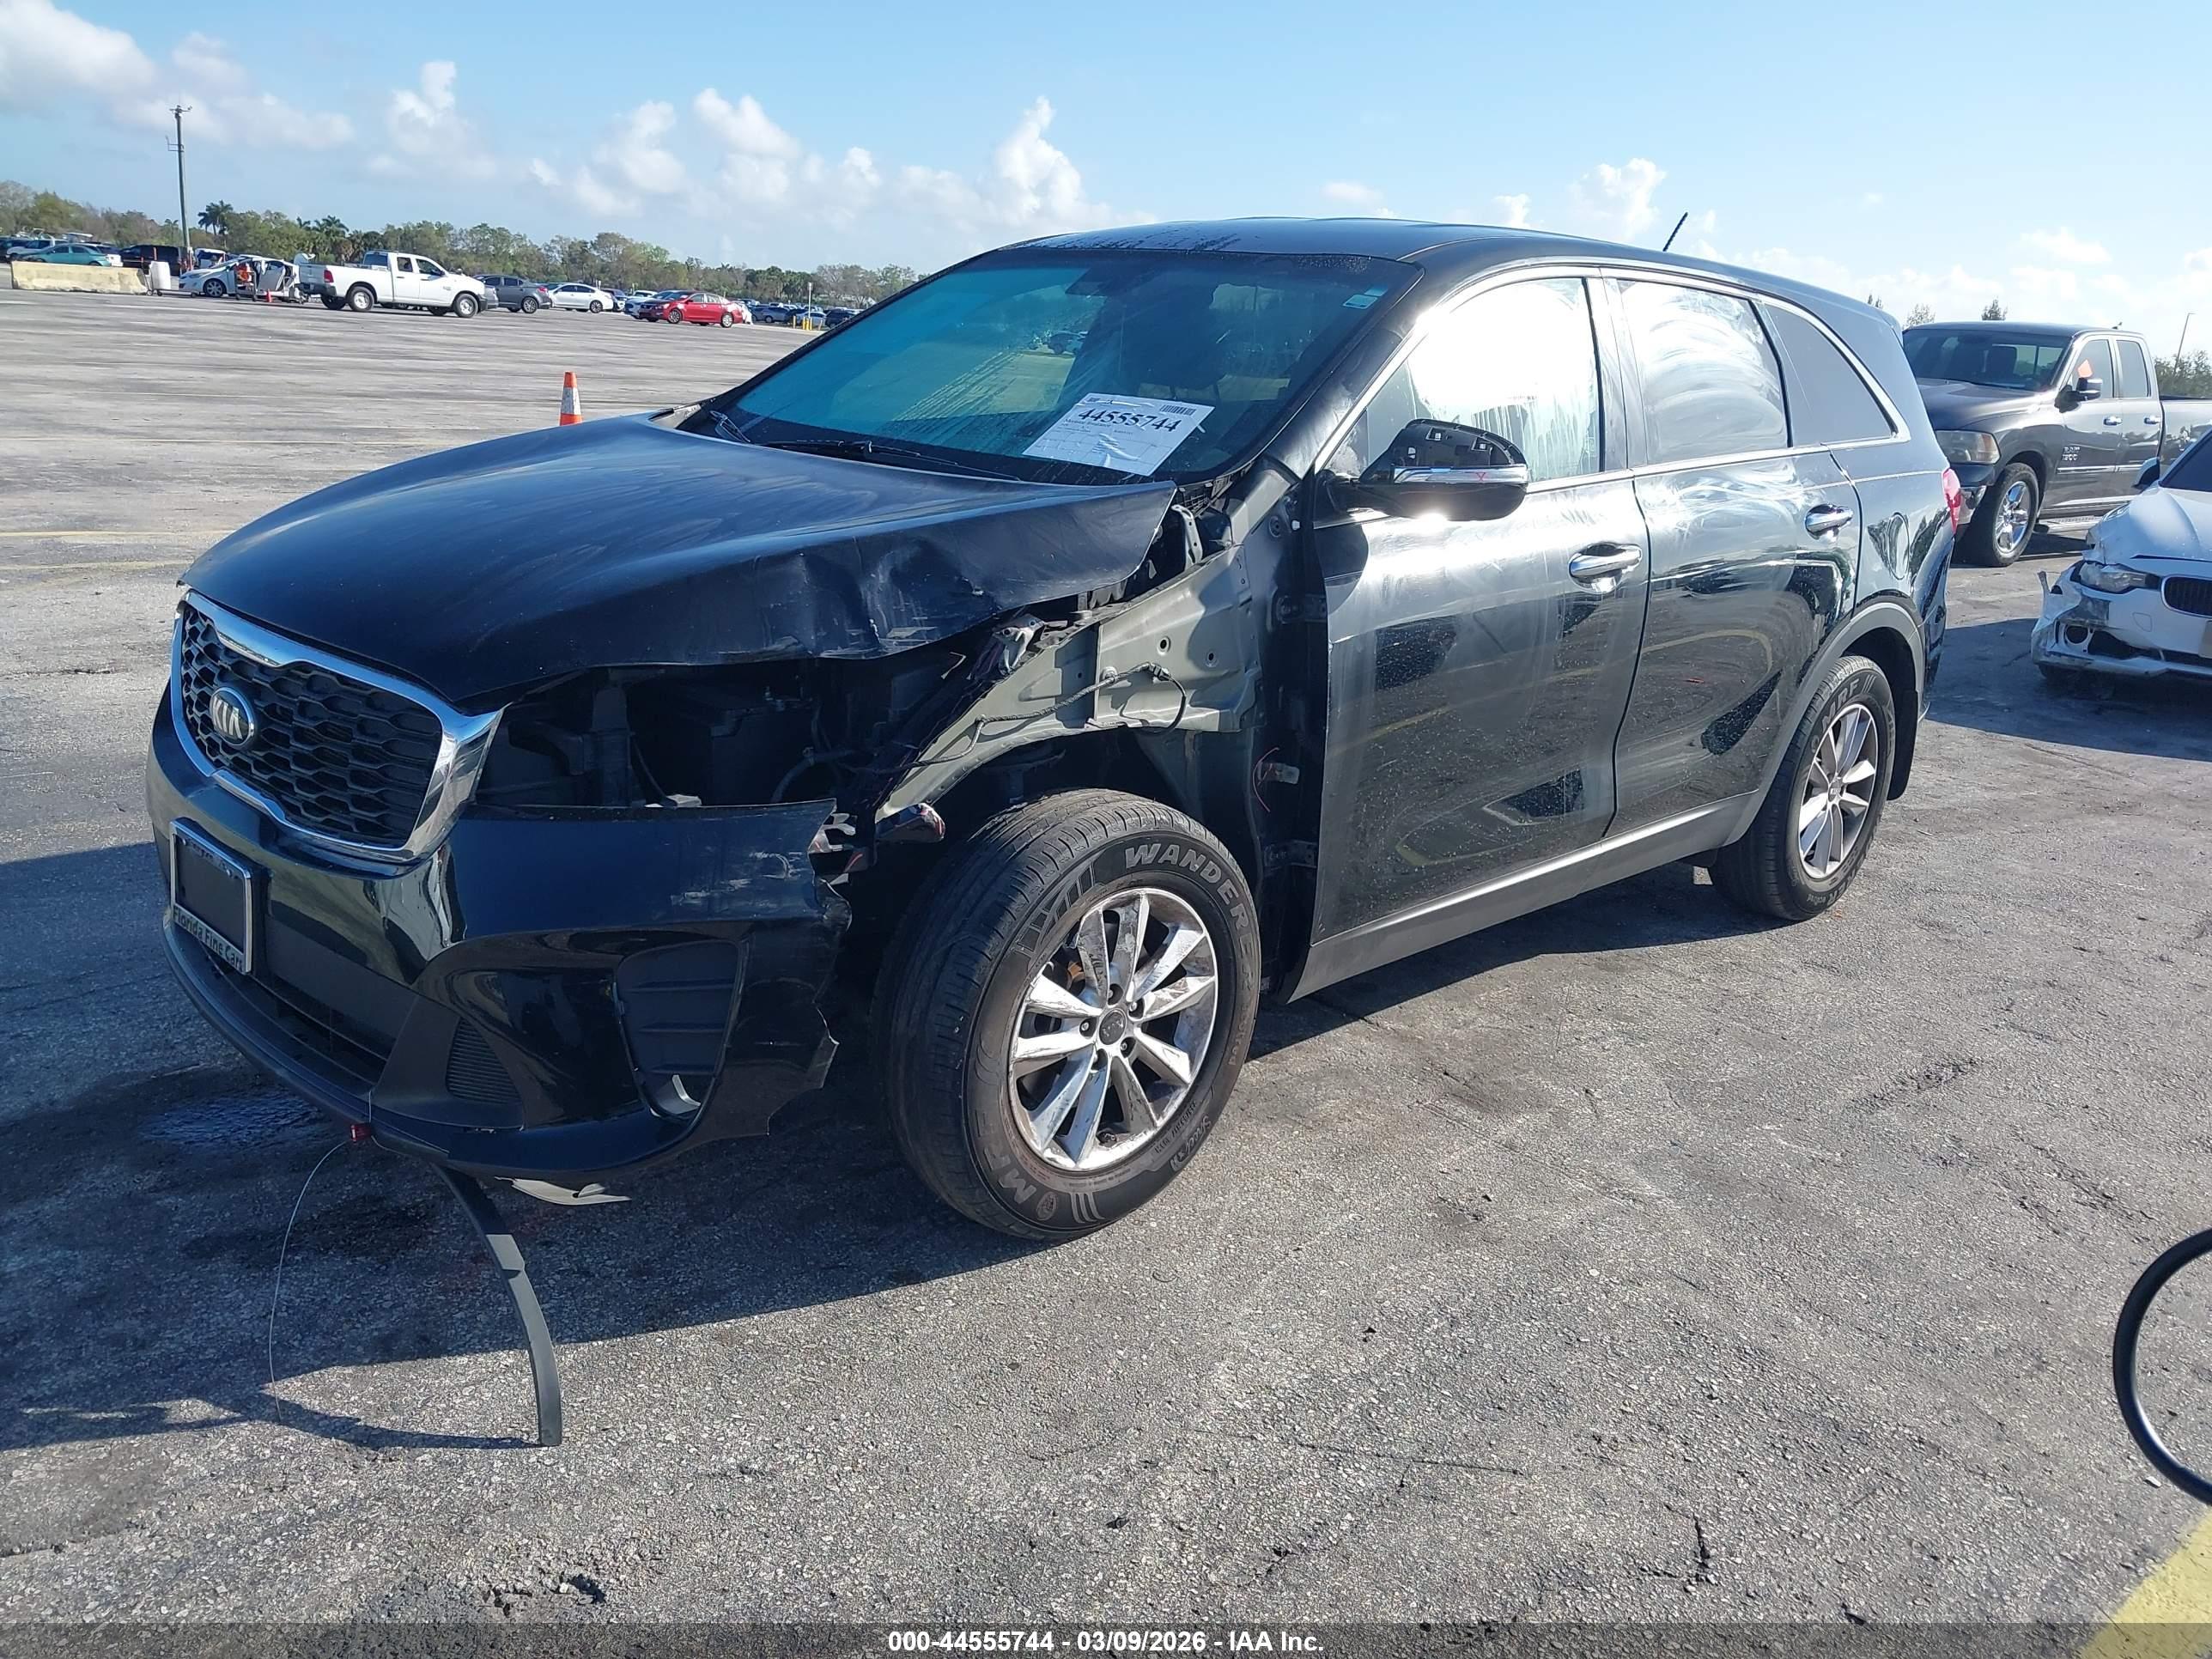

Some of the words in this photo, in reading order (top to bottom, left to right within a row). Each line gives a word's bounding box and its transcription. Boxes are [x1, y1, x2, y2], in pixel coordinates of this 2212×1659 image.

[1078, 408, 1182, 432] 44555744
[212, 695, 243, 739] KIA
[173, 904, 203, 940] Florida
[205, 927, 224, 957] Fine
[225, 945, 244, 972] Cars
[1125, 843, 1256, 991] WANDERER
